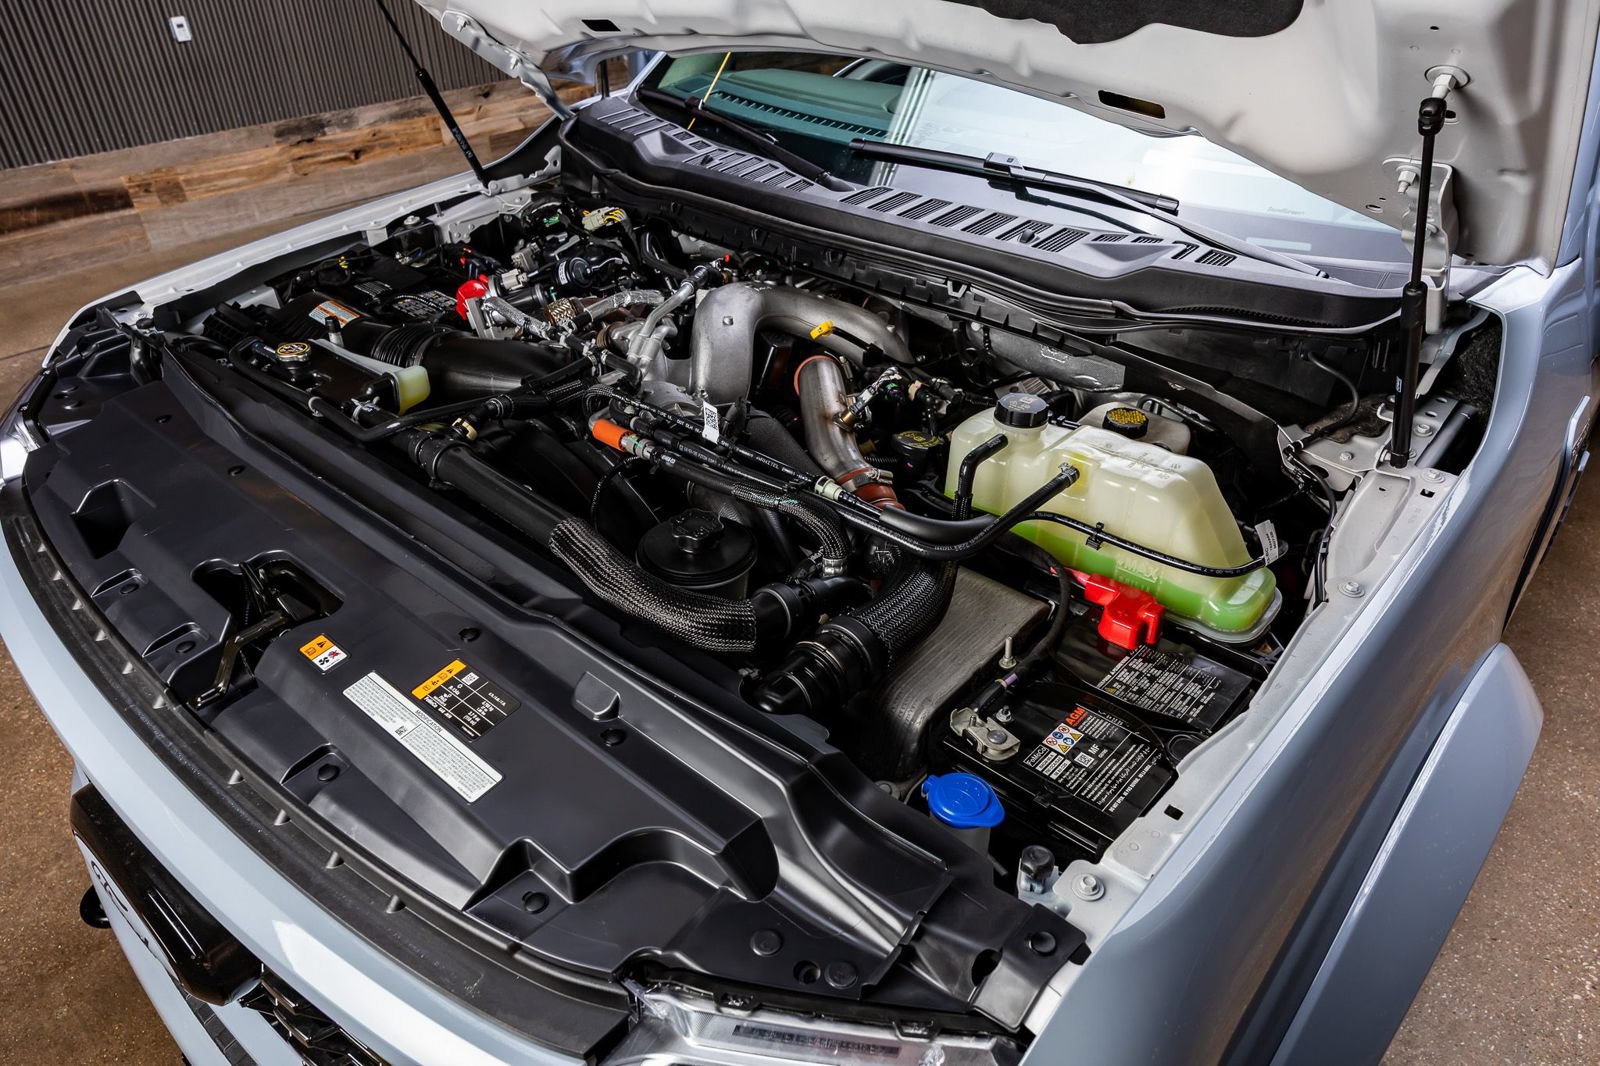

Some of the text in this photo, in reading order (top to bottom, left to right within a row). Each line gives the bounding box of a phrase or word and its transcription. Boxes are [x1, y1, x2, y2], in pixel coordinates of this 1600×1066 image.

[414, 710, 443, 733] MODIFICATION
[1065, 707, 1086, 725] AGM
[1026, 746, 1048, 767] FoMoCo
[1088, 742, 1100, 755] MF
